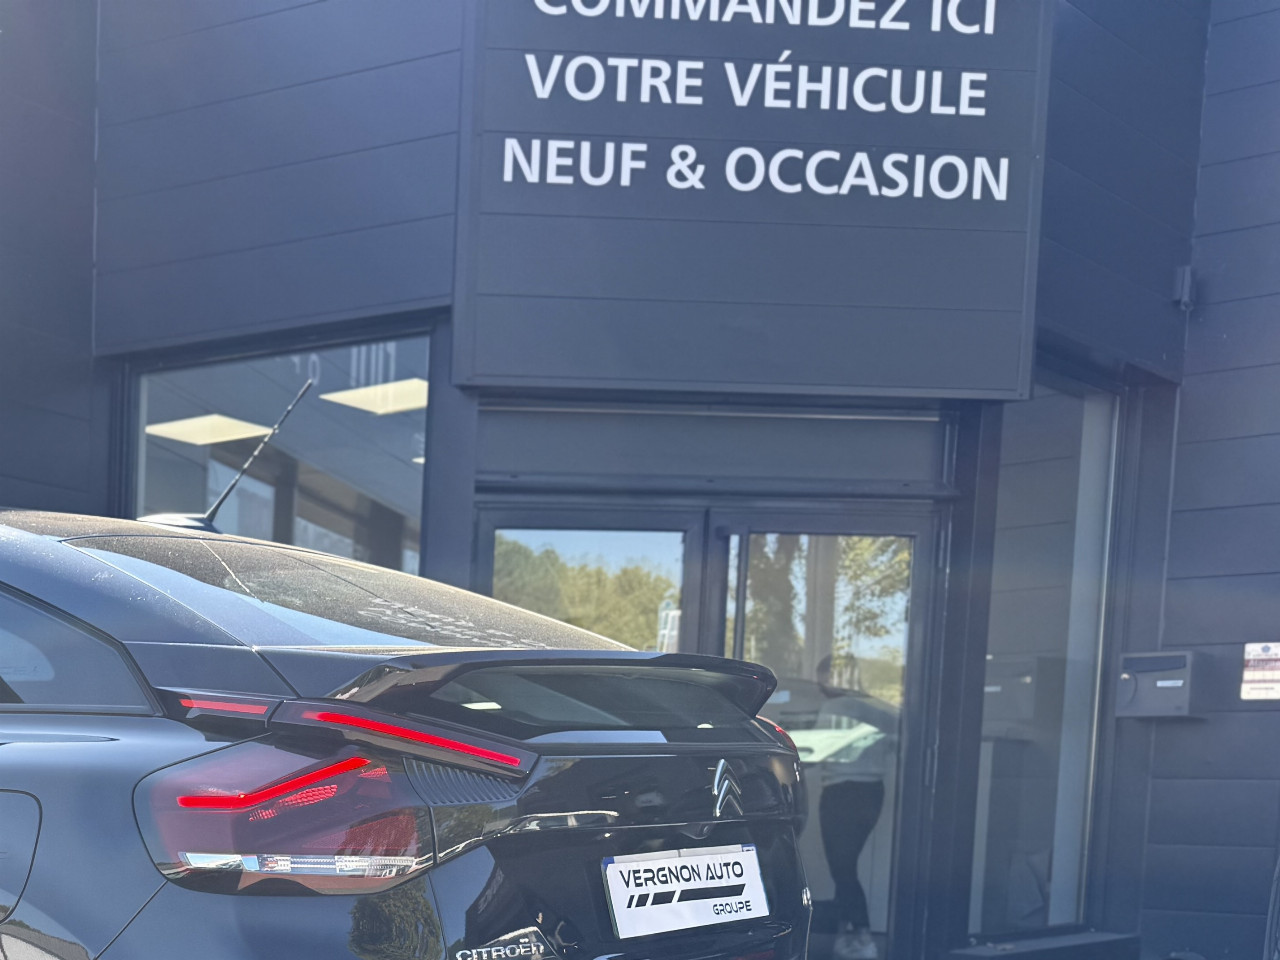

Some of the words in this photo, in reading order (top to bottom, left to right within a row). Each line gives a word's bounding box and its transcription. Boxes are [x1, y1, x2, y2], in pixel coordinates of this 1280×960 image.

[931, 0, 996, 35] ICI
[524, 53, 705, 105] VOTRE
[723, 50, 988, 117] VÉHICULE
[503, 137, 648, 187] NEUF
[666, 143, 706, 191] &
[724, 146, 1010, 201] OCCASION
[619, 863, 702, 888] VERGNON
[706, 860, 745, 881] AUTO
[712, 900, 753, 916] GROUPE
